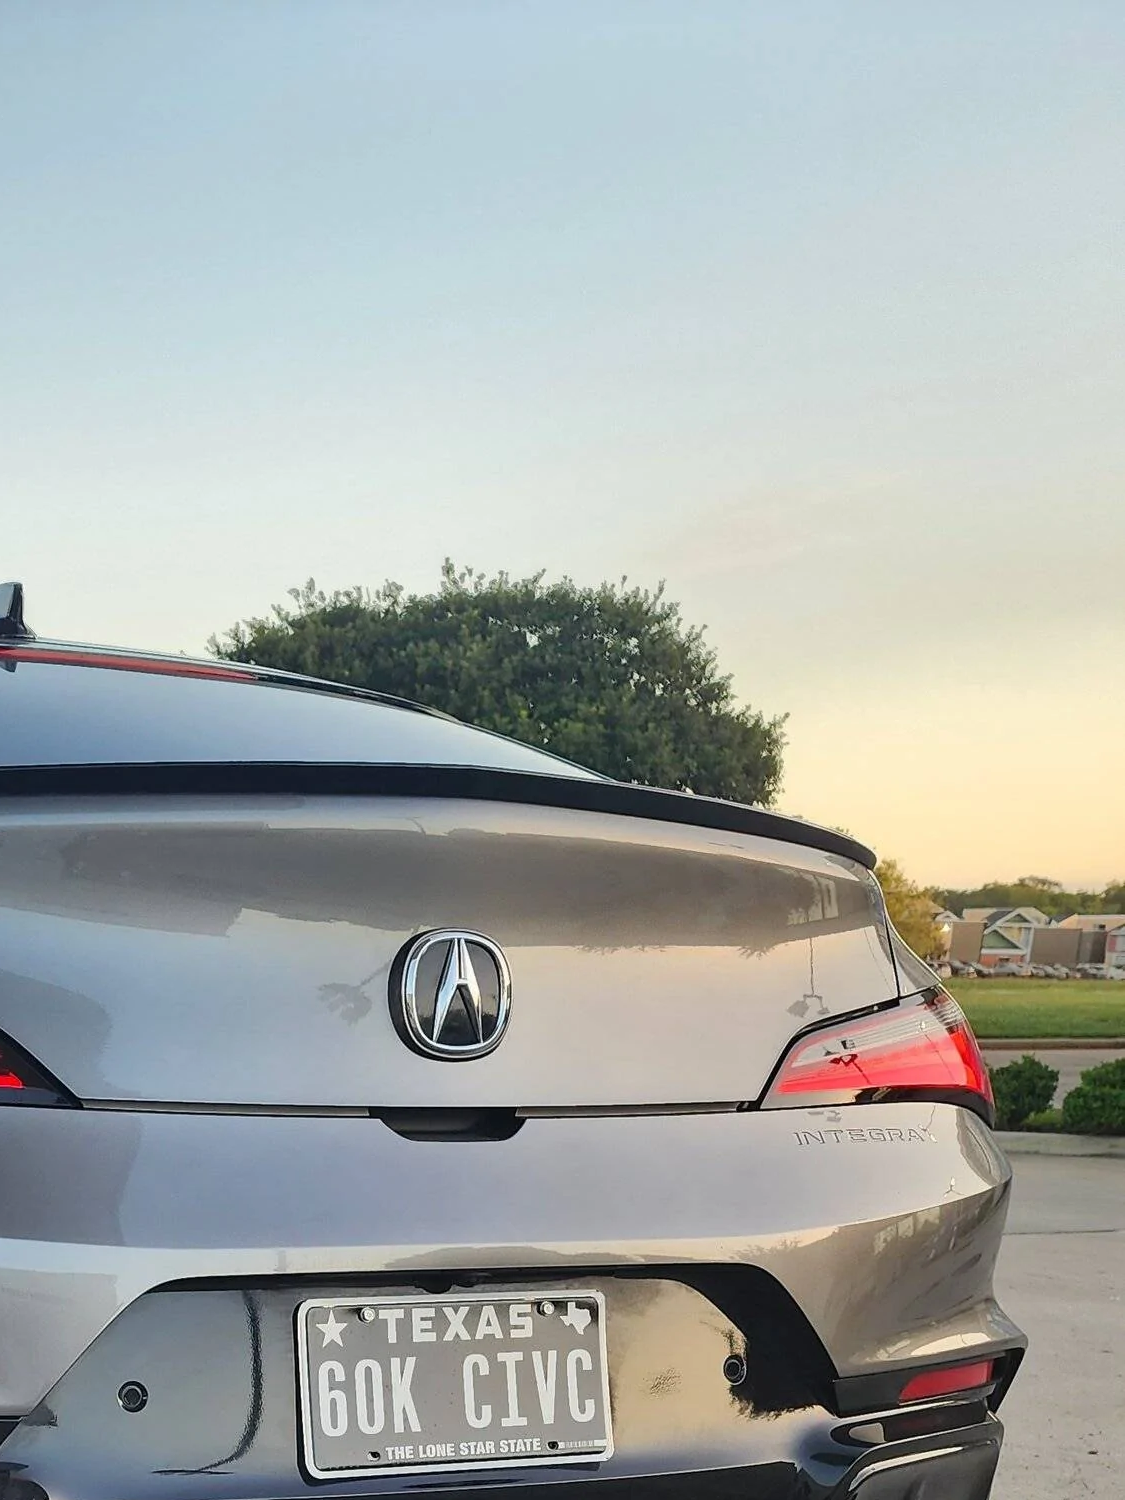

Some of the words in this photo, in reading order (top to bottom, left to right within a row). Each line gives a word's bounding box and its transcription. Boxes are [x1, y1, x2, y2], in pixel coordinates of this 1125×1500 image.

[794, 1128, 927, 1146] INTEGRA
[378, 1303, 533, 1344] TEXAS
[318, 1356, 422, 1437] 60K
[462, 1348, 596, 1429] CIVC
[385, 1446, 414, 1460] THE
[418, 1443, 455, 1459] LONE
[459, 1440, 495, 1456] STAR
[499, 1438, 542, 1453] STATE
